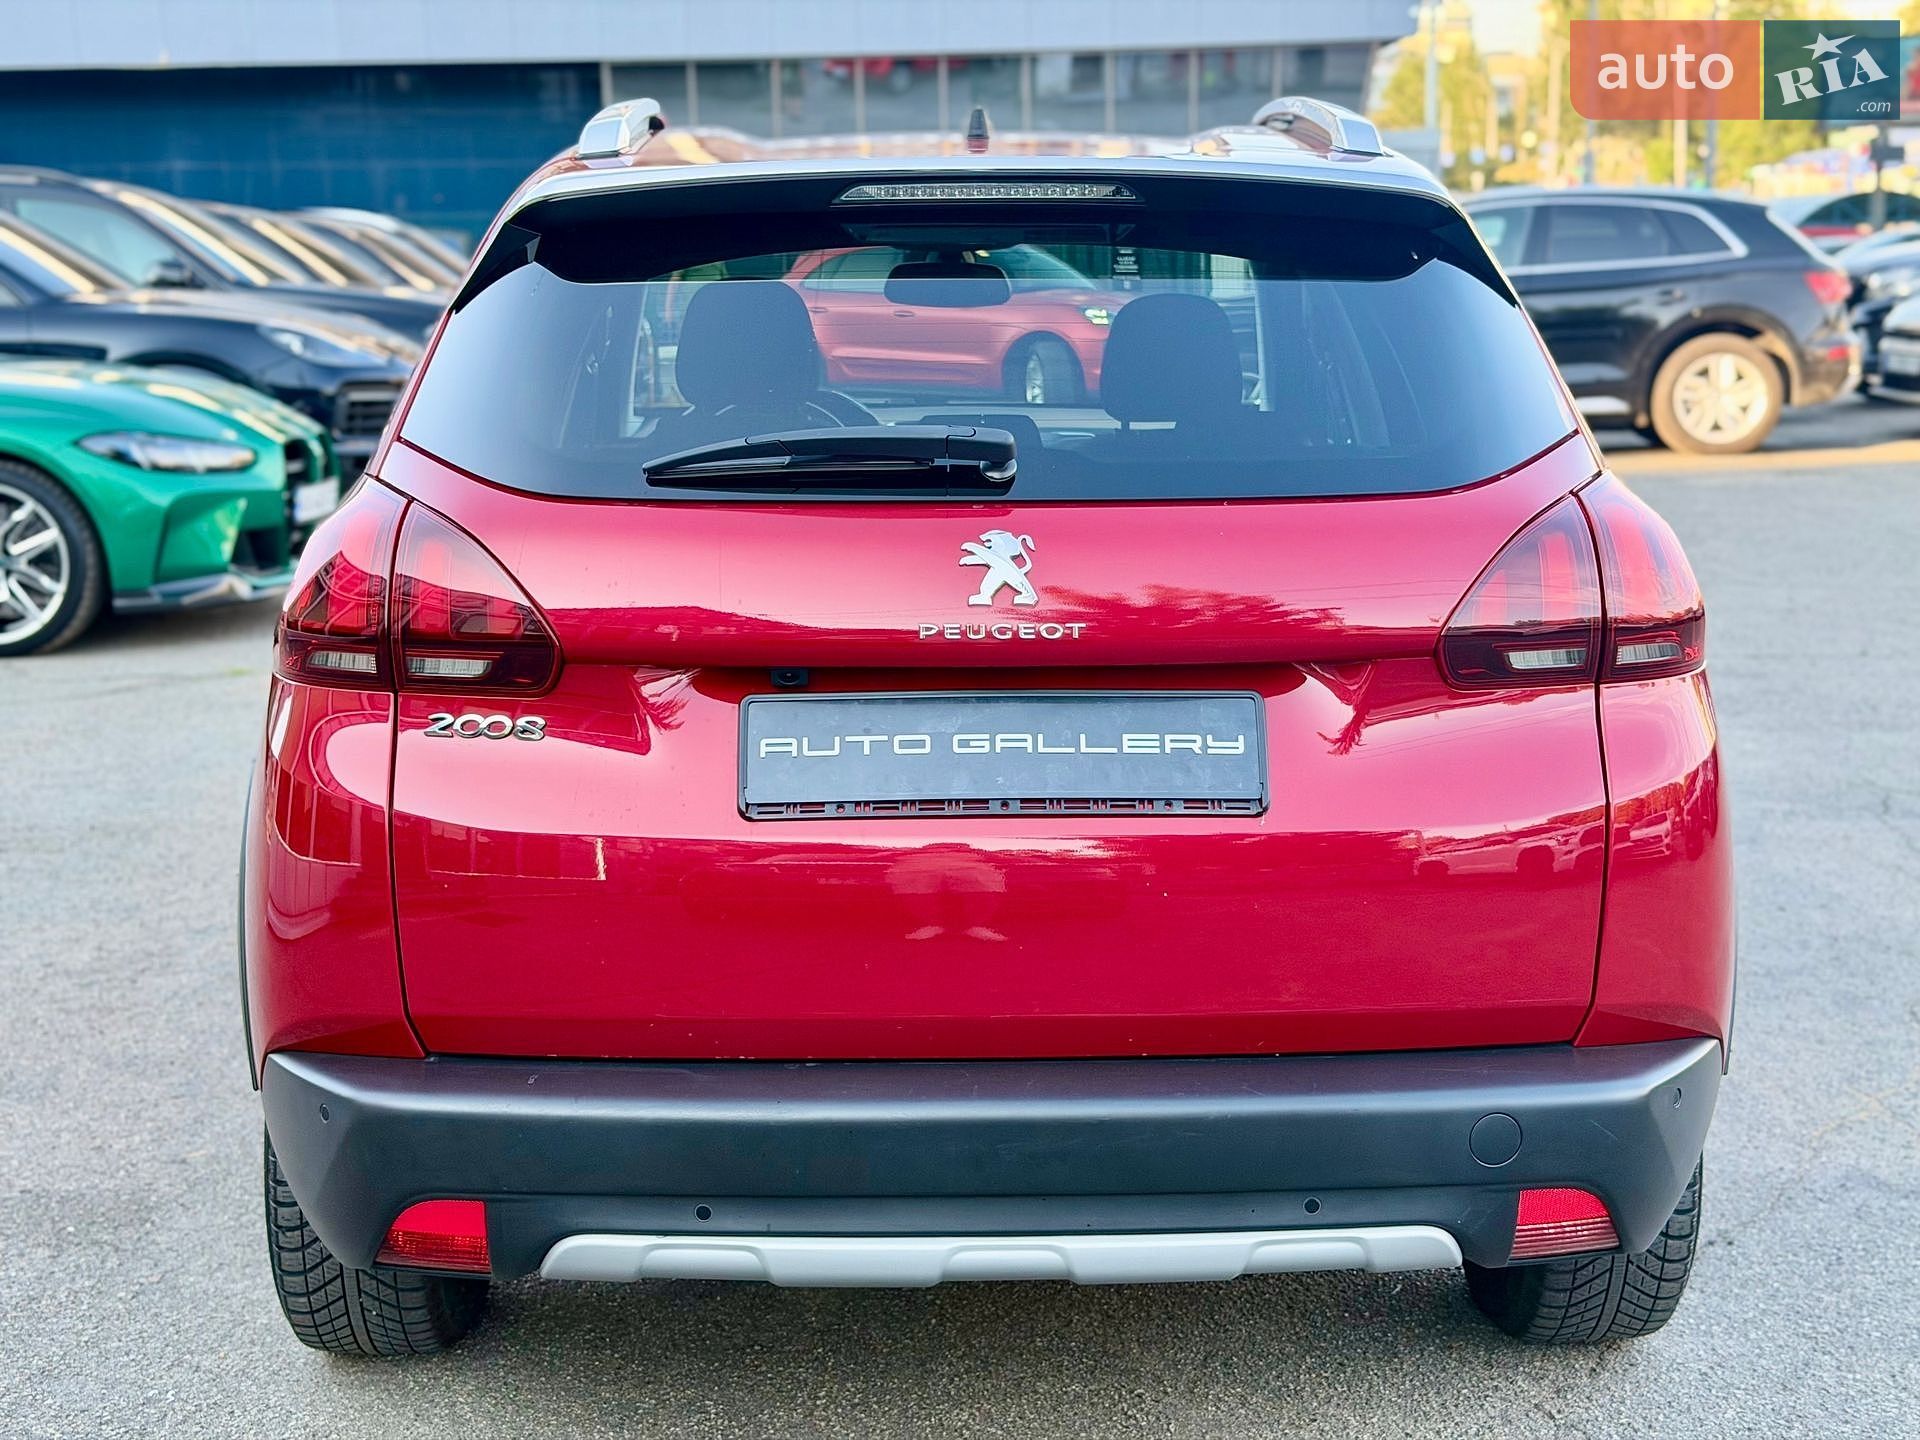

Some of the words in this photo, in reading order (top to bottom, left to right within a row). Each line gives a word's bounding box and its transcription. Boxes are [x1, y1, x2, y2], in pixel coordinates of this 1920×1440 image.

[918, 622, 1086, 640] PEUGEOT
[423, 712, 547, 741] 2008
[759, 735, 932, 758] AUTO
[952, 733, 1246, 755] GALLERY
